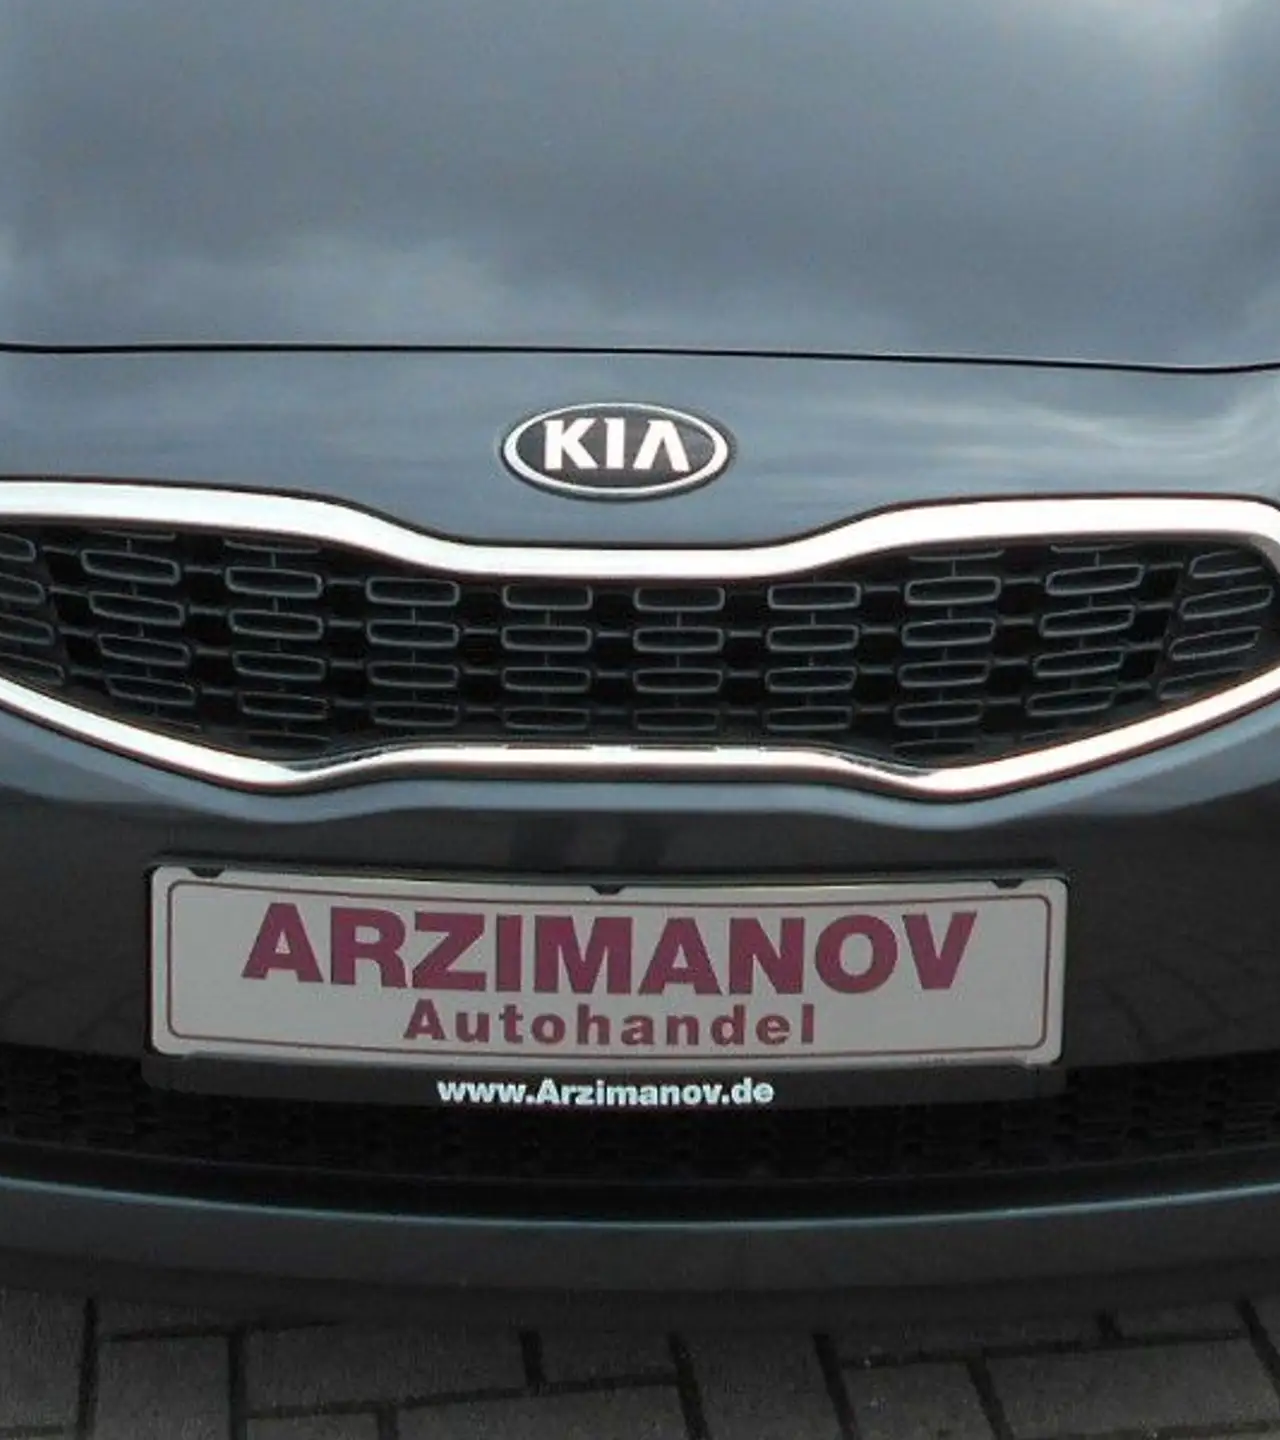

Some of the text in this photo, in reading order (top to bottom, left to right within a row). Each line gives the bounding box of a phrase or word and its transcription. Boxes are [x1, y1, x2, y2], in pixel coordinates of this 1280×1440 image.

[543, 417, 690, 471] KIA
[241, 902, 978, 996] ARZIMANOV
[403, 998, 816, 1046] Autohandel
[437, 1077, 775, 1107] www.Arzimanov.de
